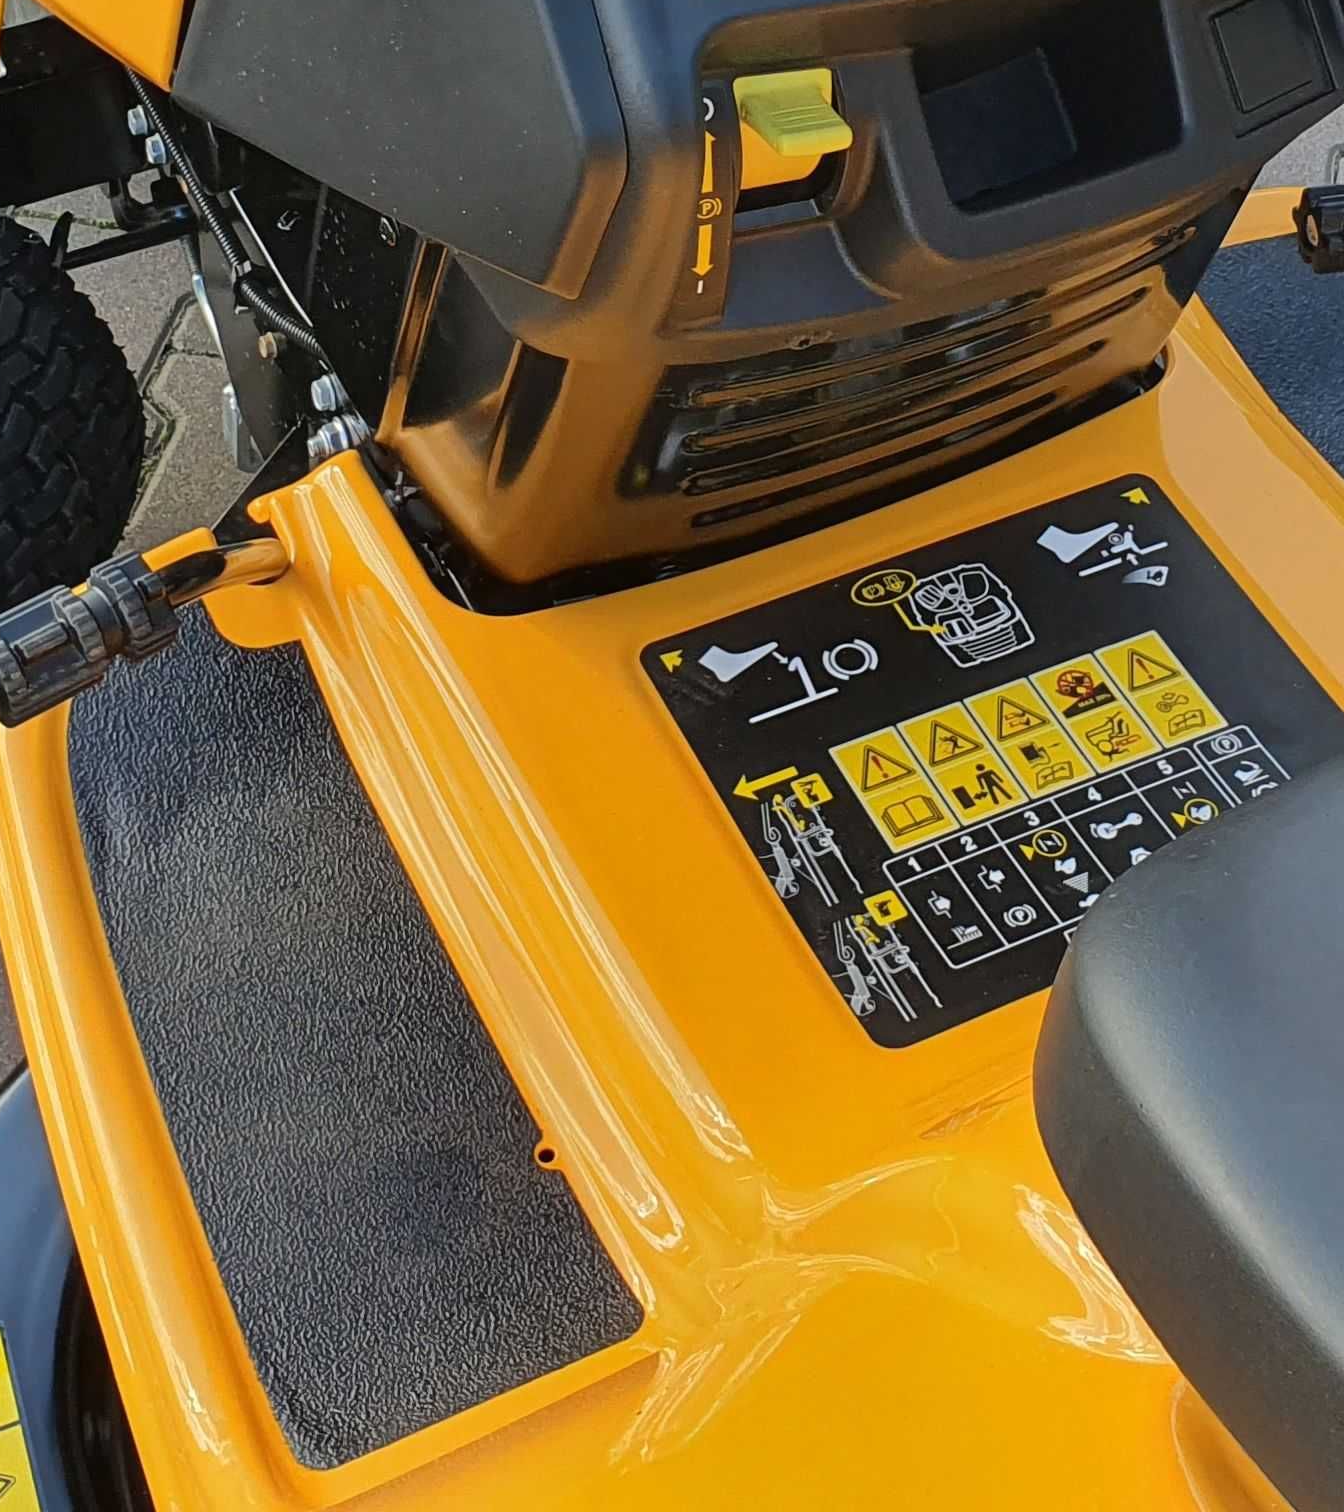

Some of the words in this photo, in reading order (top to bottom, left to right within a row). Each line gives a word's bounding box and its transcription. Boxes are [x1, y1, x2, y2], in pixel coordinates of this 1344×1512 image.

[908, 856, 922, 872] 1
[960, 836, 978, 852] 2
[1024, 811, 1040, 826] 3
[1088, 786, 1102, 801] 4
[1157, 760, 1173, 775] 5
